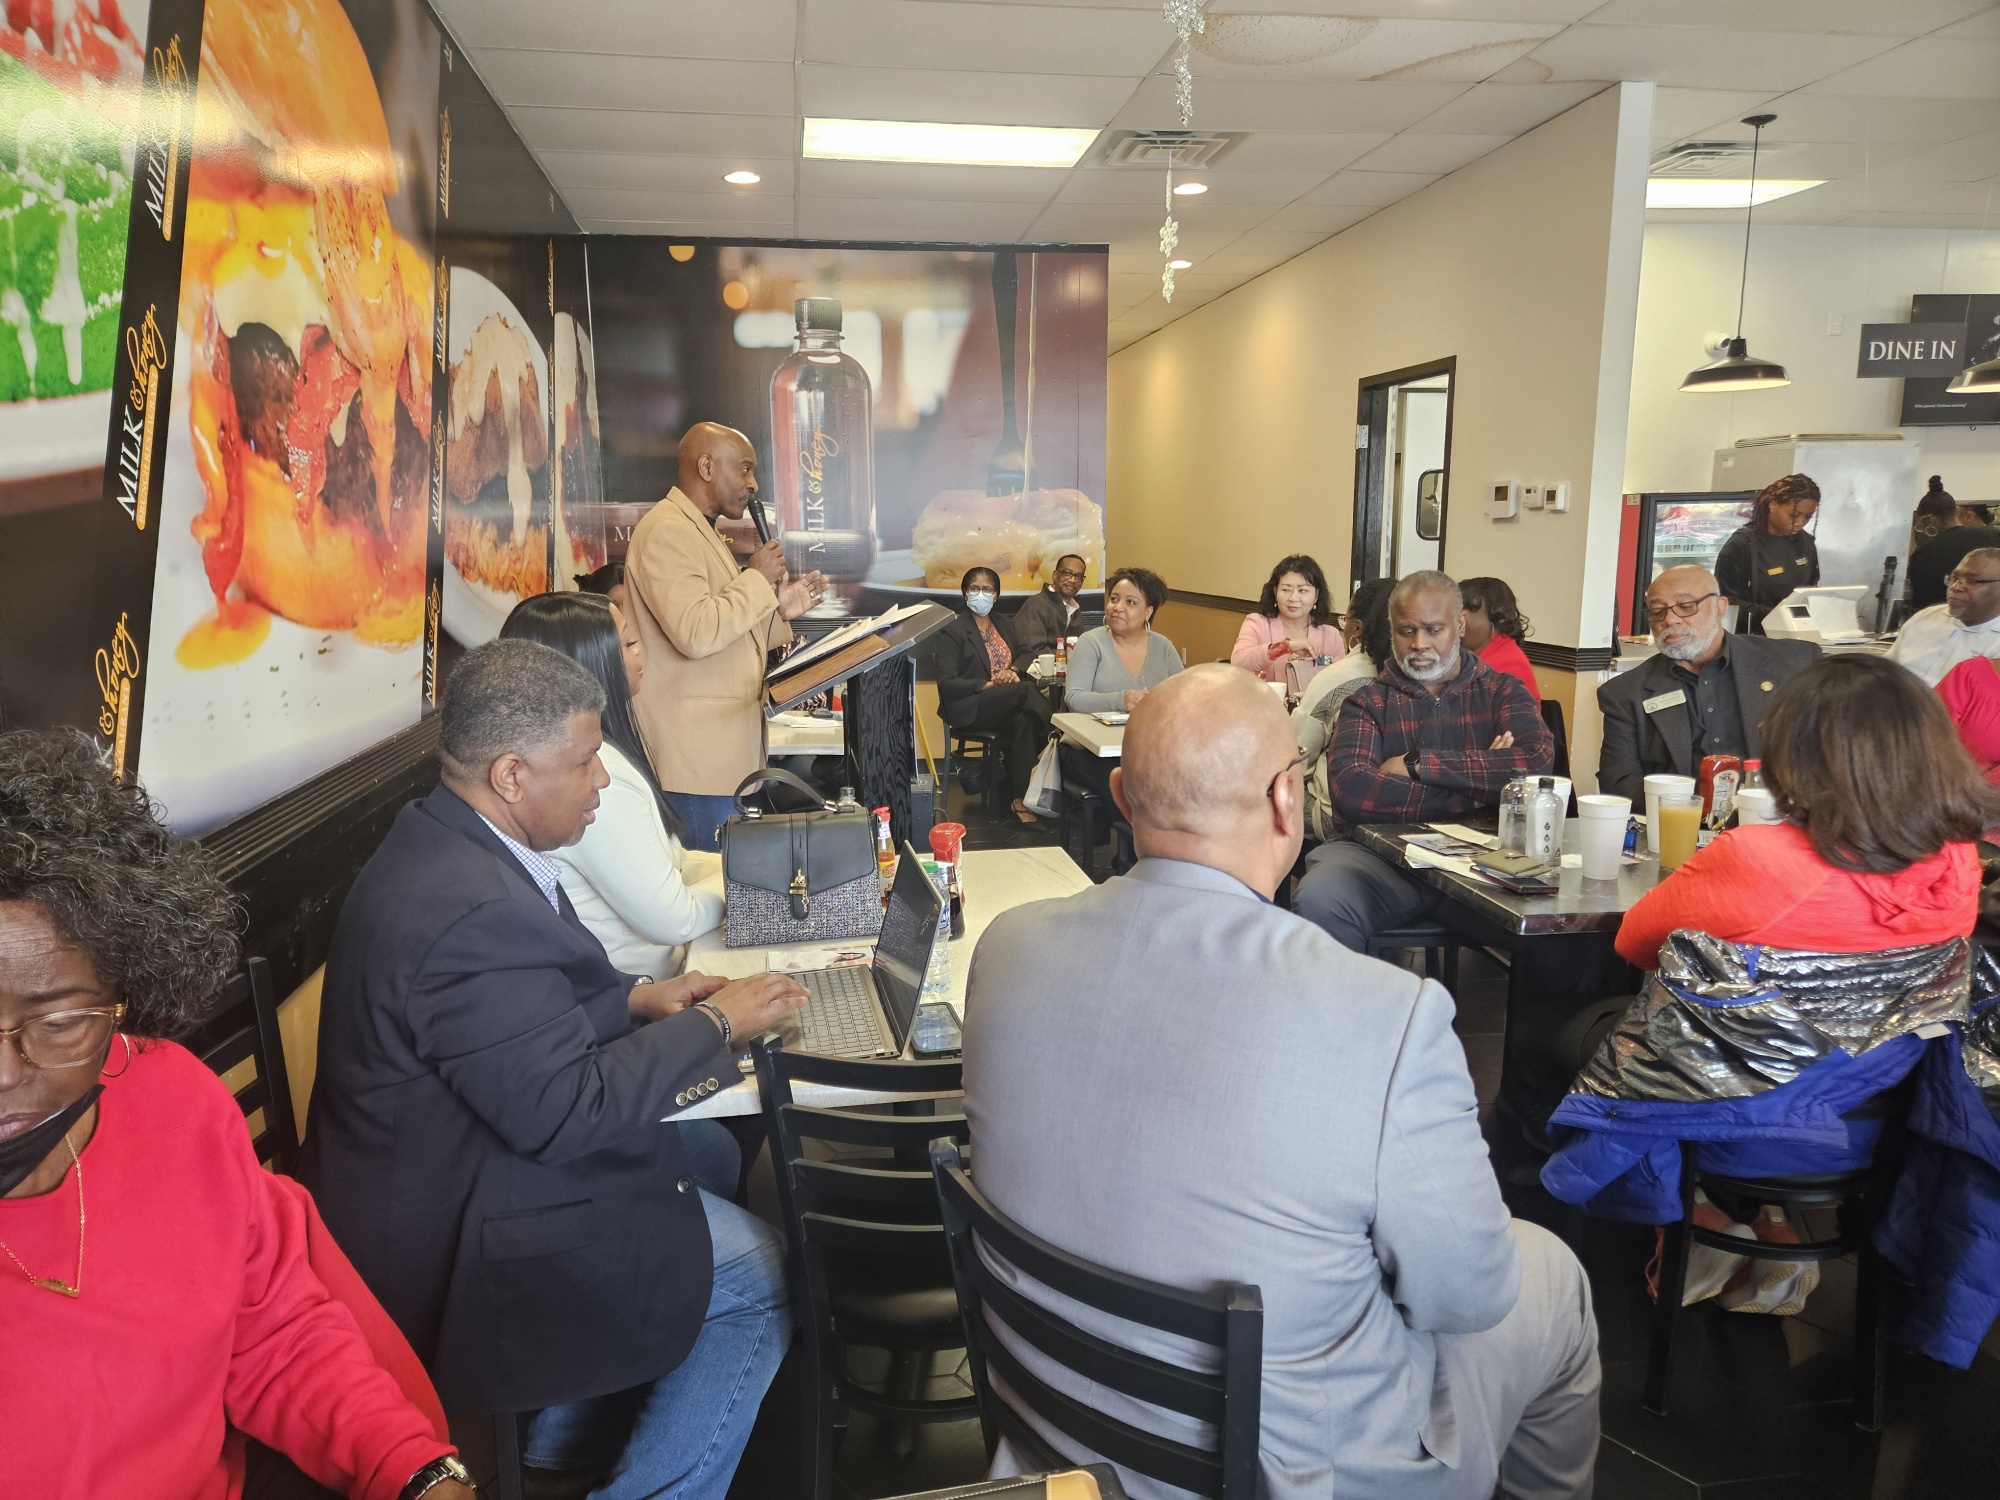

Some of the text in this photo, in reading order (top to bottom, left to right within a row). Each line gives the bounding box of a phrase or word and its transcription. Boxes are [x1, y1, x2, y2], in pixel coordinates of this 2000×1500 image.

[1868, 340, 1956, 361] DINE IN
[116, 303, 167, 521] MILK & honey
[138, 370, 158, 524] BRUNCH RESTAURANT
[432, 467, 440, 529] MILK
[800, 424, 839, 553] MILK & honey
[95, 611, 140, 714] honey
[425, 641, 434, 703] MILK
[99, 706, 114, 736] &
